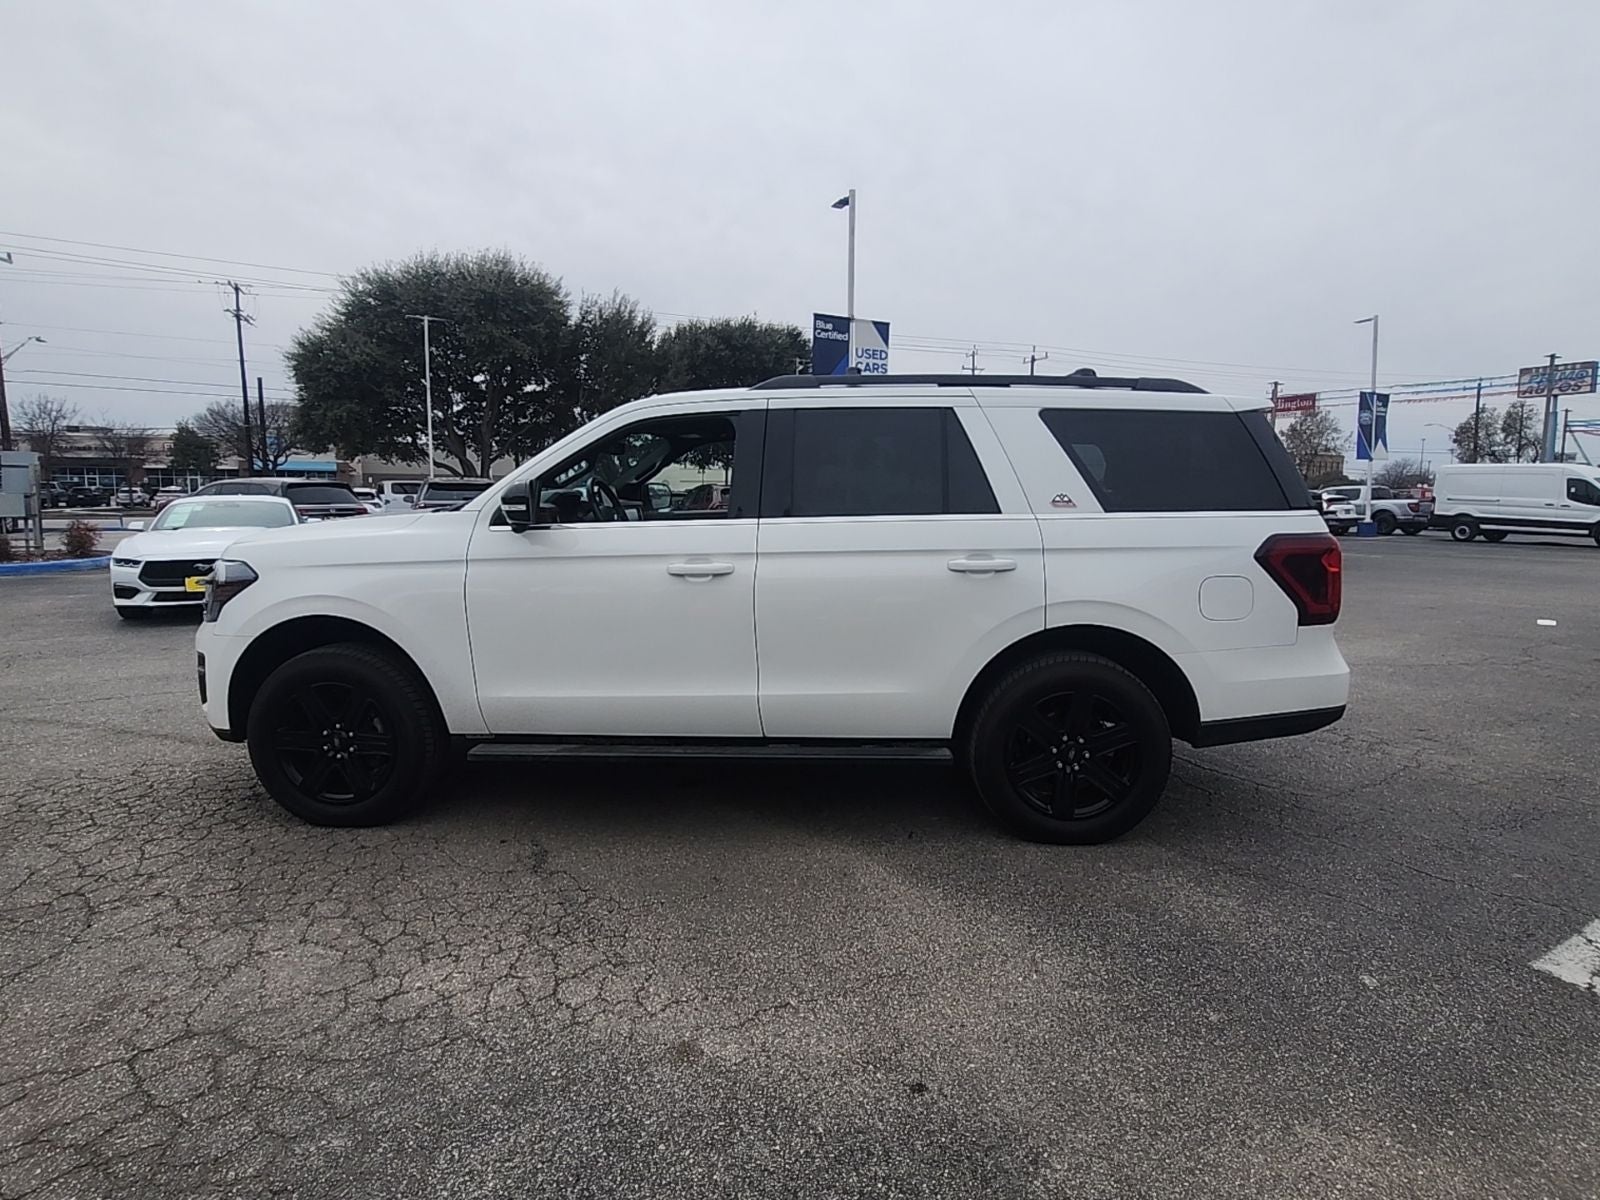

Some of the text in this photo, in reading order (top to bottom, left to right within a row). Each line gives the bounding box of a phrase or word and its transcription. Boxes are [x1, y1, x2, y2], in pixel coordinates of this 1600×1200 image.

[815, 320, 833, 330] Blue
[815, 330, 848, 341] Certified
[855, 347, 888, 361] USED
[855, 361, 888, 374] CARS
[1275, 398, 1313, 411] lington
